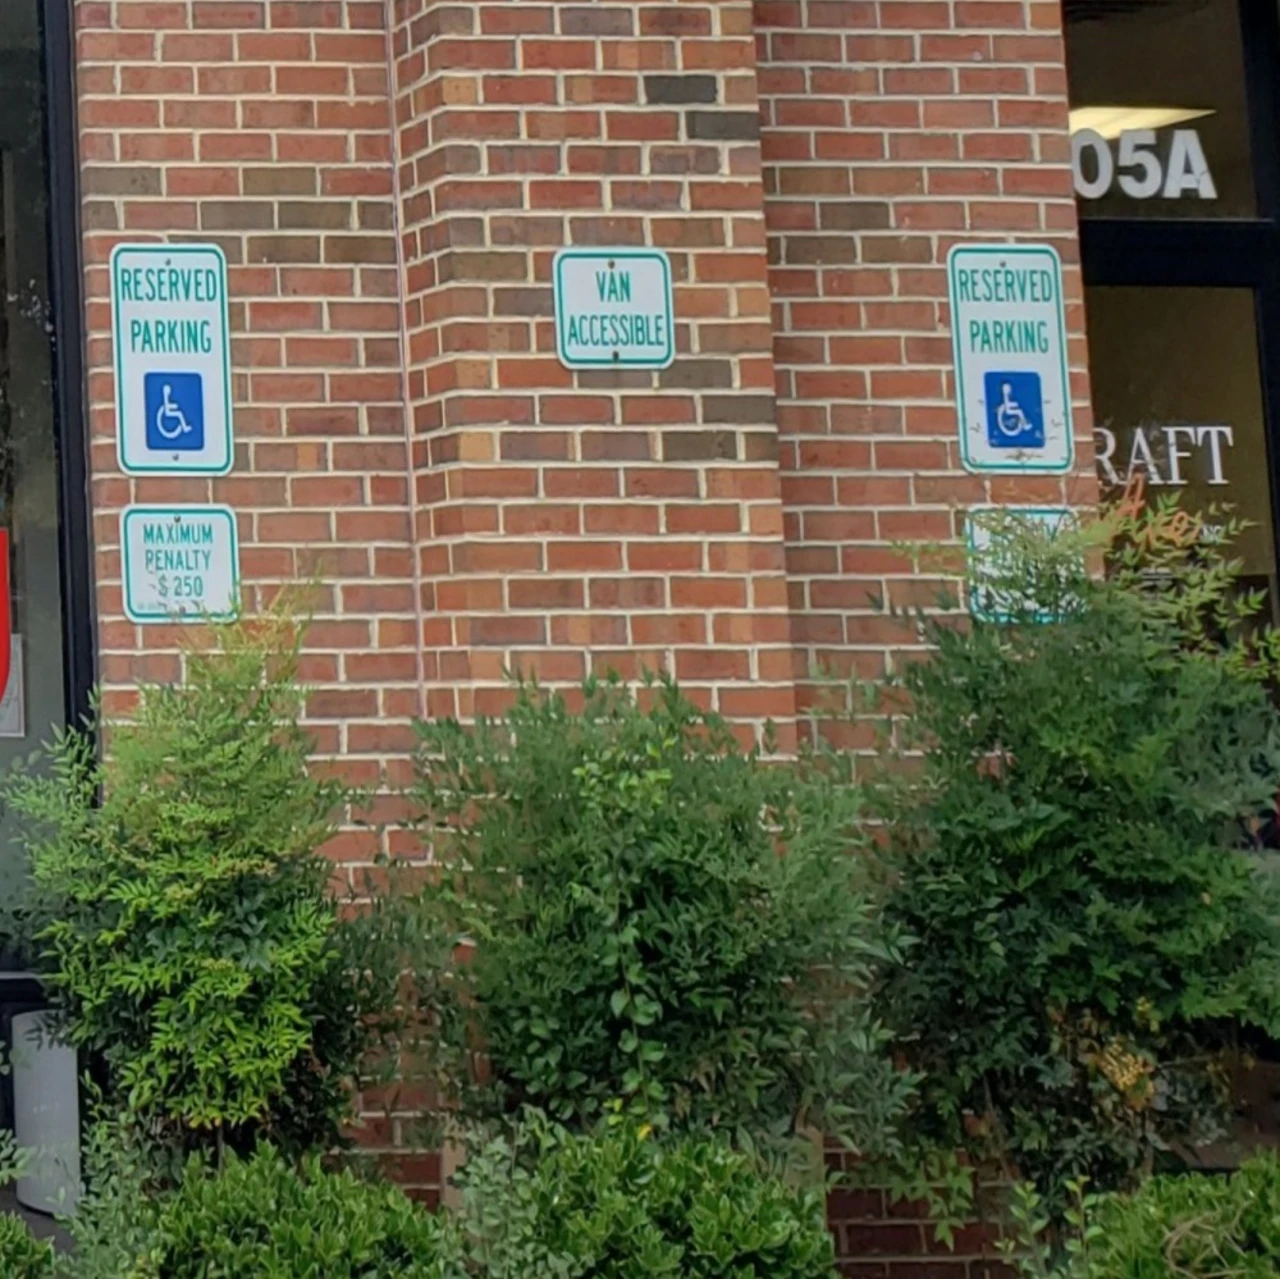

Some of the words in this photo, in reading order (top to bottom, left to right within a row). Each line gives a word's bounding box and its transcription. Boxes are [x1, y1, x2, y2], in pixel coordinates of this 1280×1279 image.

[120, 267, 217, 302] RESERVED
[595, 271, 631, 303] VAN
[958, 268, 1052, 303] RESERVED
[130, 319, 212, 354] PARKING
[567, 314, 665, 346] ACCESSIBLE
[969, 320, 1049, 354] PARKING
[143, 523, 213, 544] MAXIMUM
[145, 549, 211, 571] PENALTY
